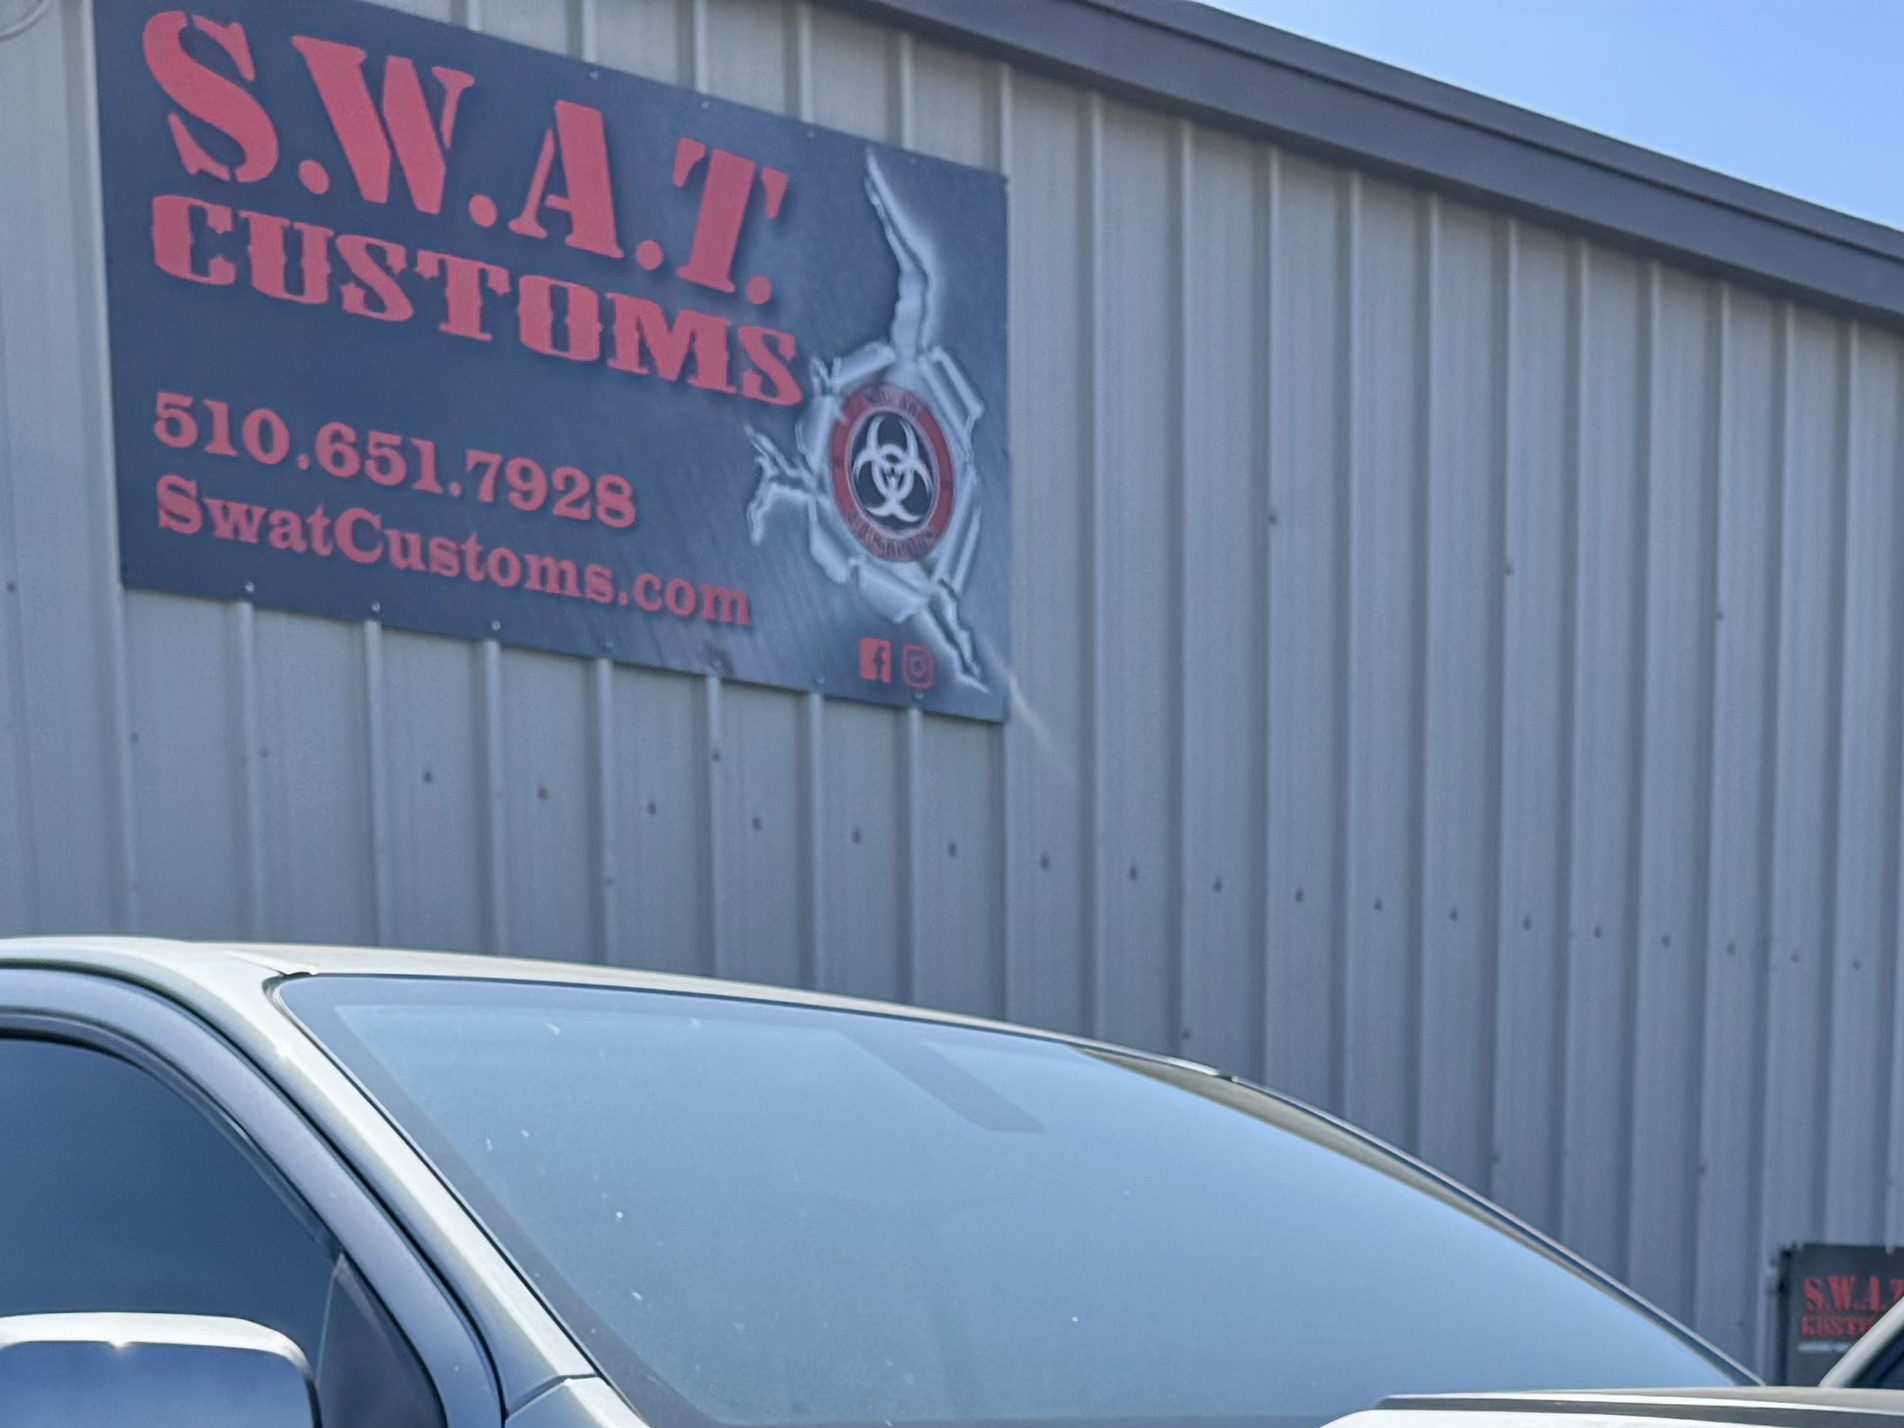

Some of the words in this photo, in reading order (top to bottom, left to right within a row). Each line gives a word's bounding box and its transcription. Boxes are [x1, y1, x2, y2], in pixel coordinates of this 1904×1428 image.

[143, 11, 787, 304] S.W.A.T.
[152, 195, 802, 405] CUSTOMS
[154, 392, 635, 527] 510.651.7928
[156, 475, 752, 626] SwatCustoms.com
